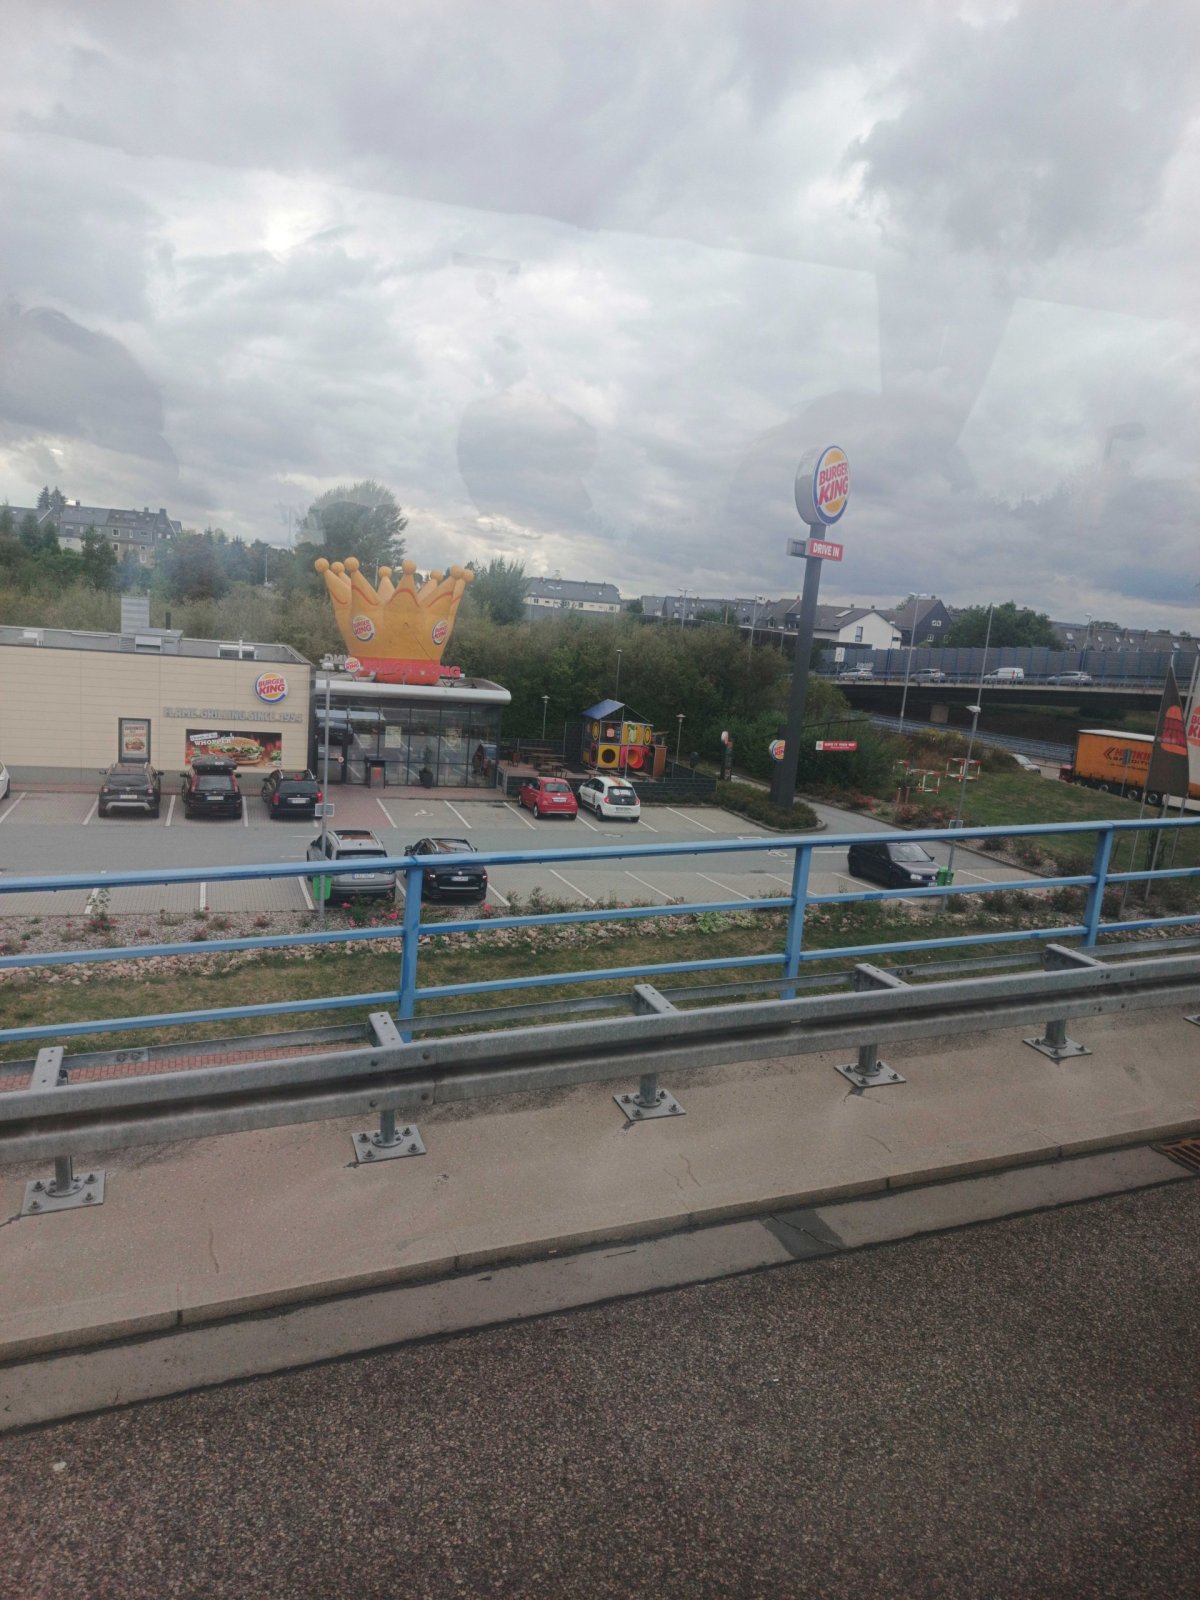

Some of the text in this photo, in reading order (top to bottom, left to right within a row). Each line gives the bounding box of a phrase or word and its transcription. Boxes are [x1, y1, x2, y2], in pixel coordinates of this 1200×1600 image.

[819, 462, 849, 486] BURGER
[818, 475, 849, 506] KING
[813, 542, 840, 558] DRIVE IN
[354, 624, 372, 636] KING
[259, 678, 285, 688] BURGER
[259, 683, 286, 696] KING
